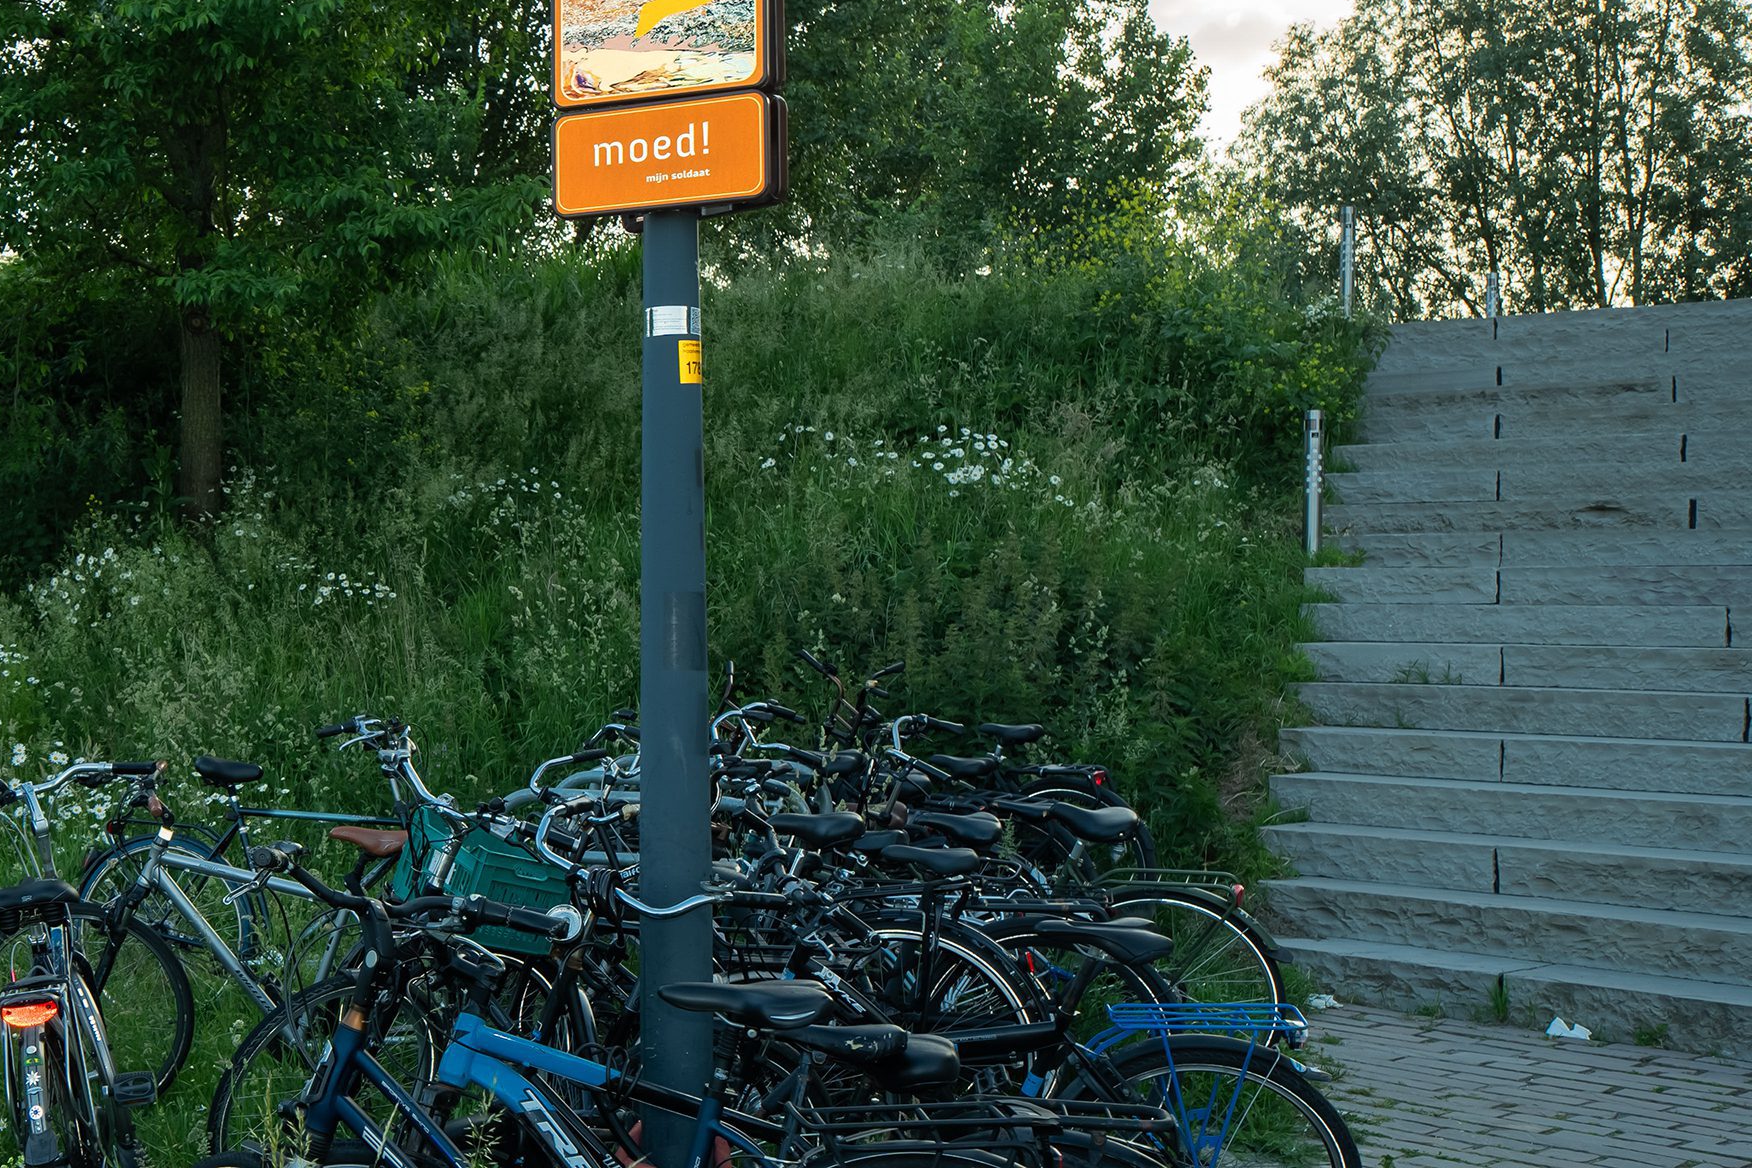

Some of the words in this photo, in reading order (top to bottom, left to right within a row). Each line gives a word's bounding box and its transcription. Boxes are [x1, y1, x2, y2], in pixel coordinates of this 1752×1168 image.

[593, 121, 710, 167] moed!
[646, 173, 669, 184] mijn
[671, 168, 710, 180] soldaat
